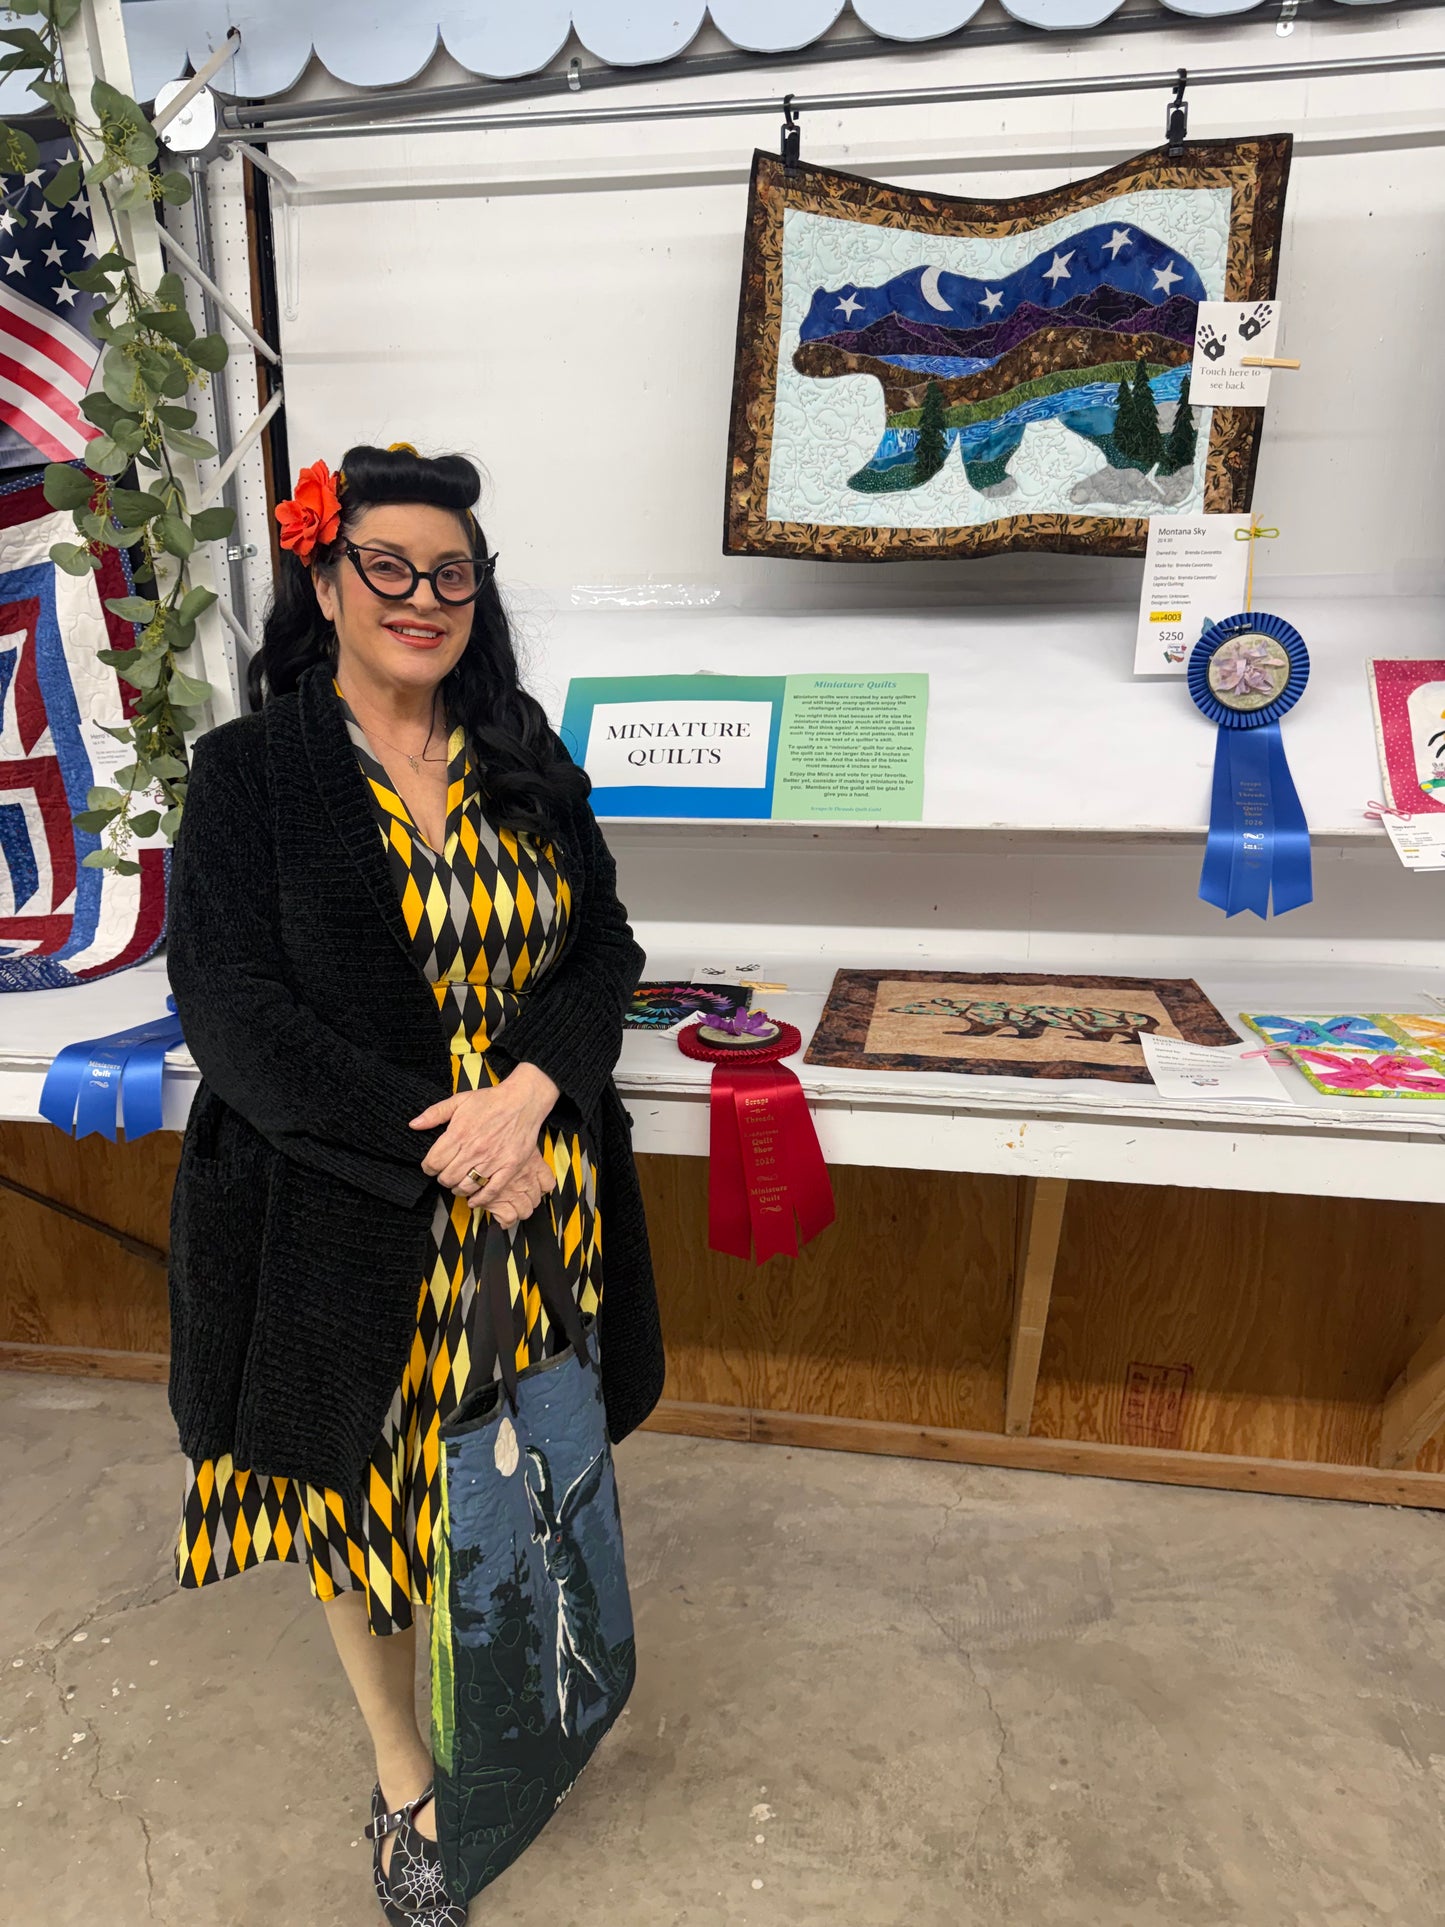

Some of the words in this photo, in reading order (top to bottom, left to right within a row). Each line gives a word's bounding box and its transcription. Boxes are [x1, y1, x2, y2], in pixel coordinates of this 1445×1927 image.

[1200, 367, 1226, 376] Touch
[1229, 367, 1249, 376] here
[1252, 367, 1260, 376] to
[1193, 528, 1206, 536] Sky
[1159, 632, 1183, 641] $250
[607, 722, 751, 740] MINIATURE
[627, 748, 722, 767] QUILTS
[88, 1061, 120, 1069] Miniature
[92, 1069, 111, 1077] Quilt
[752, 1138, 773, 1146] Quilt
[751, 1186, 788, 1196] Miniature
[760, 1194, 780, 1203] Quilt
